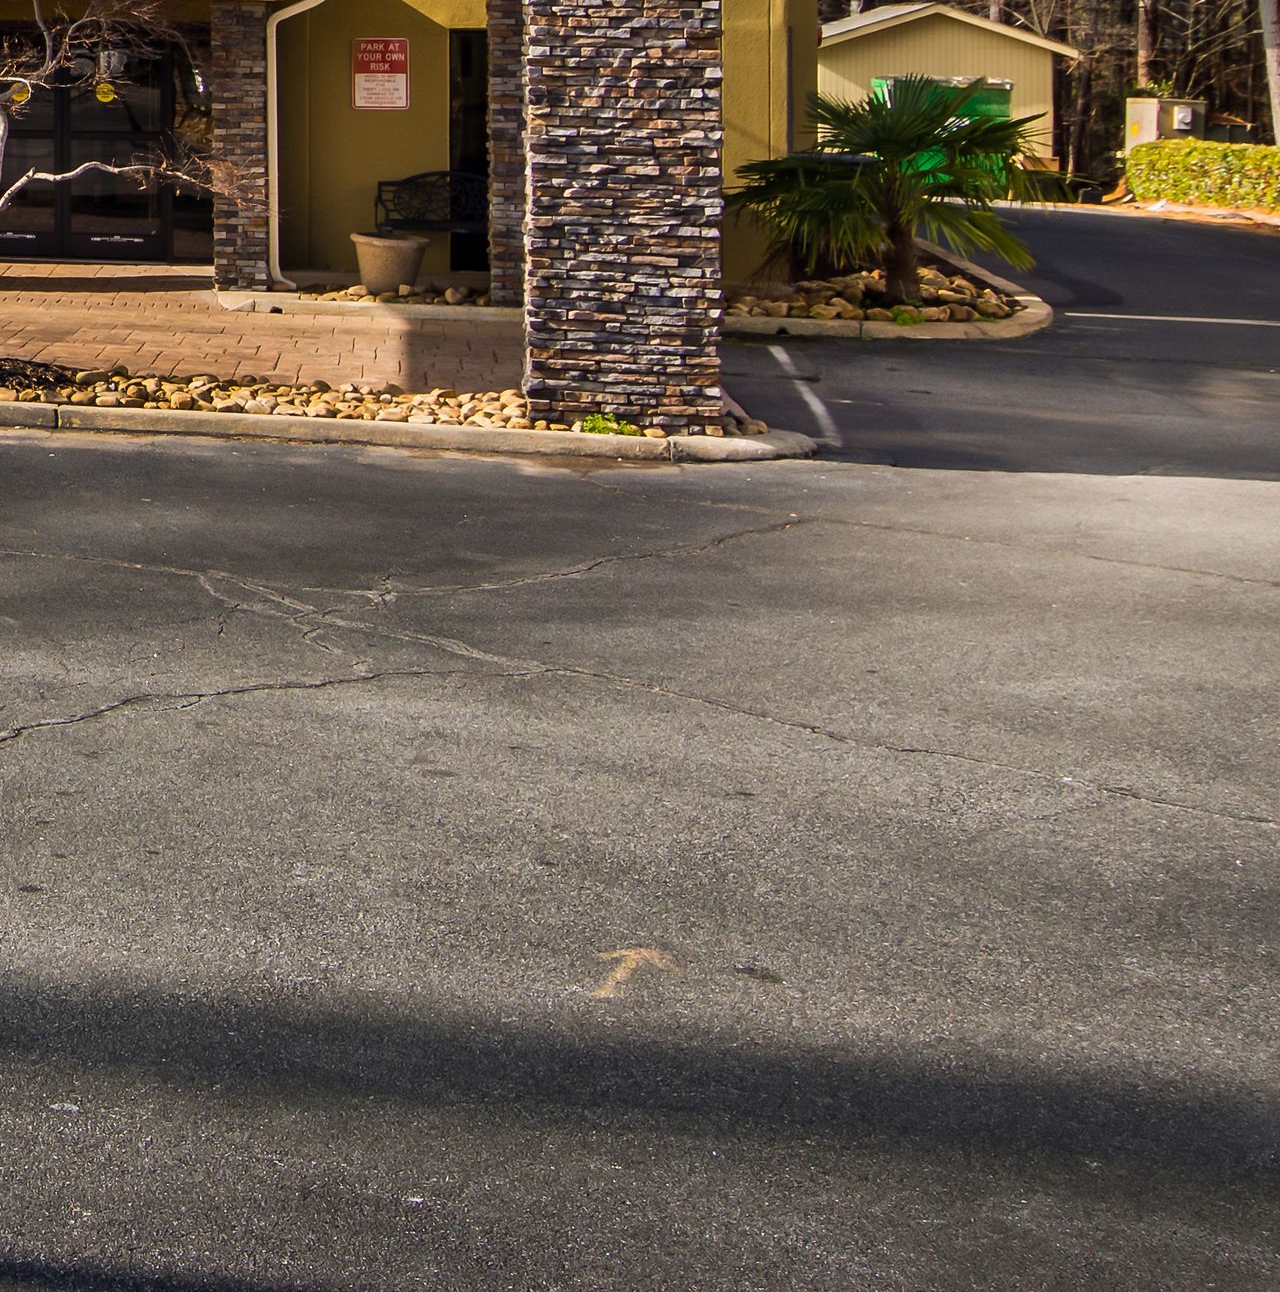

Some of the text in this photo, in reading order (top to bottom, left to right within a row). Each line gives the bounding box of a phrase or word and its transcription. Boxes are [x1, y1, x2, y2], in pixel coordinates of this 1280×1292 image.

[360, 43, 400, 51] PARK AT
[357, 53, 405, 61] YOUR OWN
[370, 63, 391, 71] RISK
